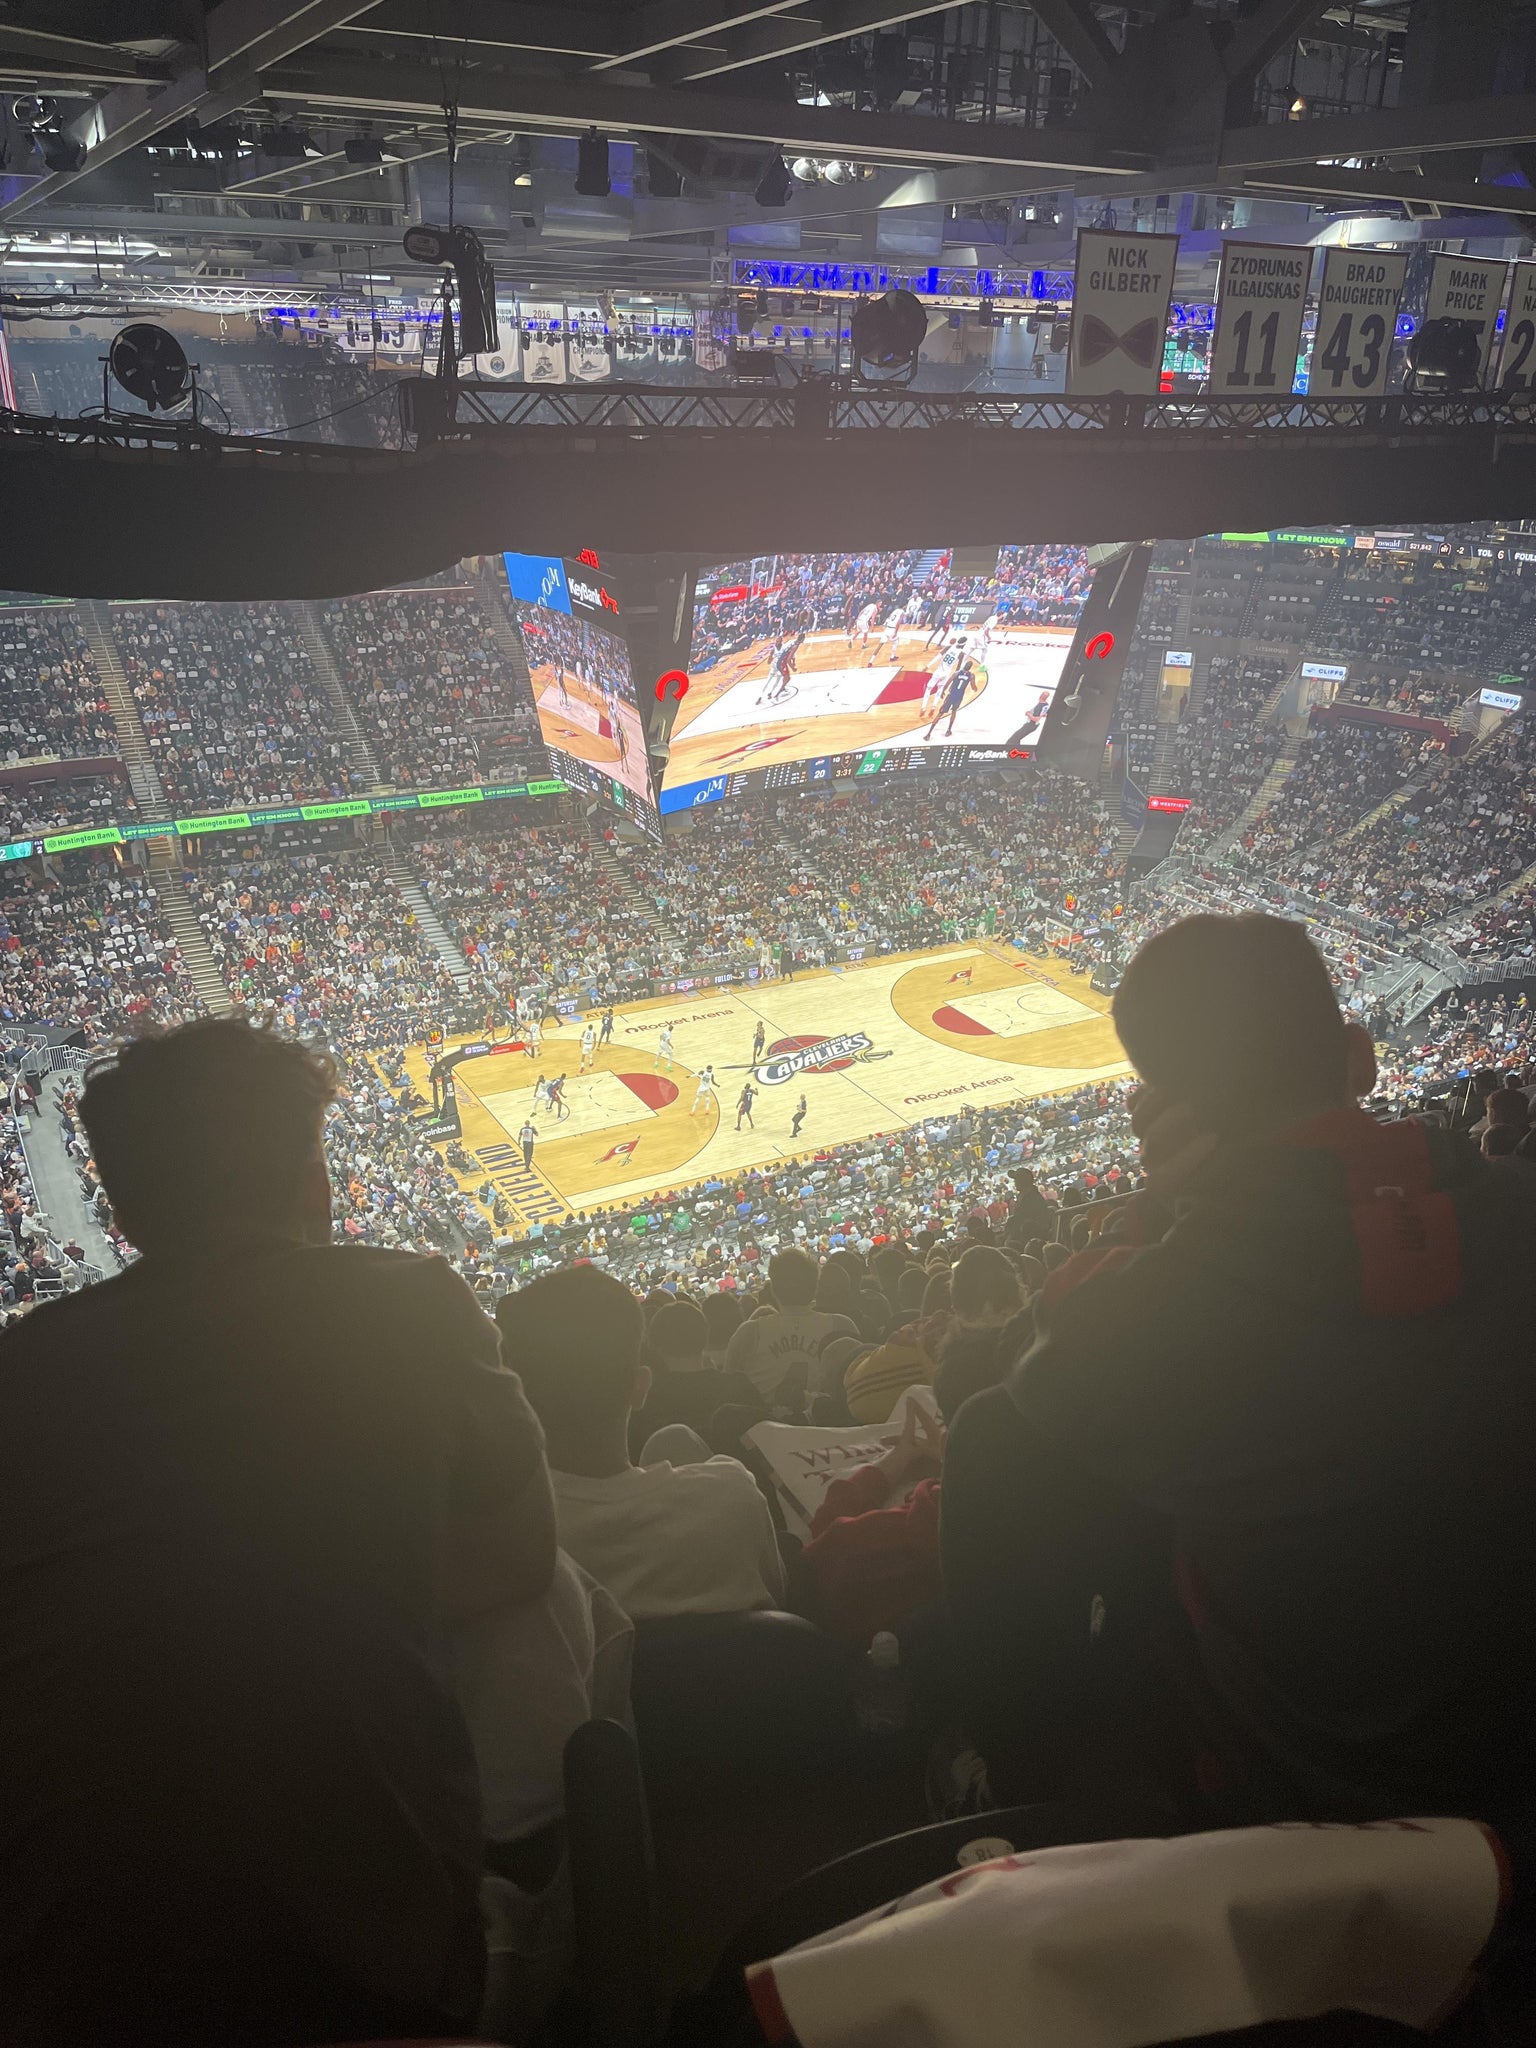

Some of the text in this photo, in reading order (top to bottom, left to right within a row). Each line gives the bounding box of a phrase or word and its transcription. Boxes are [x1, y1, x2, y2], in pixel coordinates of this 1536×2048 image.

[1107, 247, 1148, 269] NICK
[1230, 256, 1302, 279] ZYDRUNAS
[1089, 270, 1162, 293] GILBERT
[1346, 263, 1386, 283] BRAD
[1449, 269, 1489, 290] MARK
[1226, 278, 1301, 301] ILGAUSKAS
[1325, 285, 1402, 307] DAUGHERTY
[1444, 290, 1486, 311] PRICE
[533, 310, 551, 319] 2016
[1226, 311, 1280, 386] 11
[1321, 313, 1386, 389] 43
[1277, 533, 1297, 542] LET
[1297, 535, 1312, 543] EM
[1312, 536, 1347, 545] KNOW.
[1377, 540, 1400, 548] oswald
[1477, 549, 1504, 560] TOL 6
[567, 577, 602, 607] KeyBank
[1318, 668, 1344, 677] CLIFFS
[968, 750, 1007, 760] KeyBank
[814, 763, 875, 779] 20 3:31 22
[430, 791, 479, 803] Huntington Bank
[314, 804, 366, 816] Huntington Bank
[122, 829, 138, 837] LET
[189, 816, 245, 830] Huntington Bank
[57, 831, 115, 847] Huntington Bank
[1022, 966, 1060, 988] ULTRA
[556, 999, 578, 1009] SATURDAY
[638, 1008, 735, 1032] Rocket Arena
[803, 1034, 848, 1056] CLEVELAND
[753, 1032, 871, 1086] CAVALIERS
[916, 1075, 1015, 1102] Rocket Arena
[475, 1143, 565, 1220] CLEVELAND
[768, 1334, 820, 1360] MOBLE
